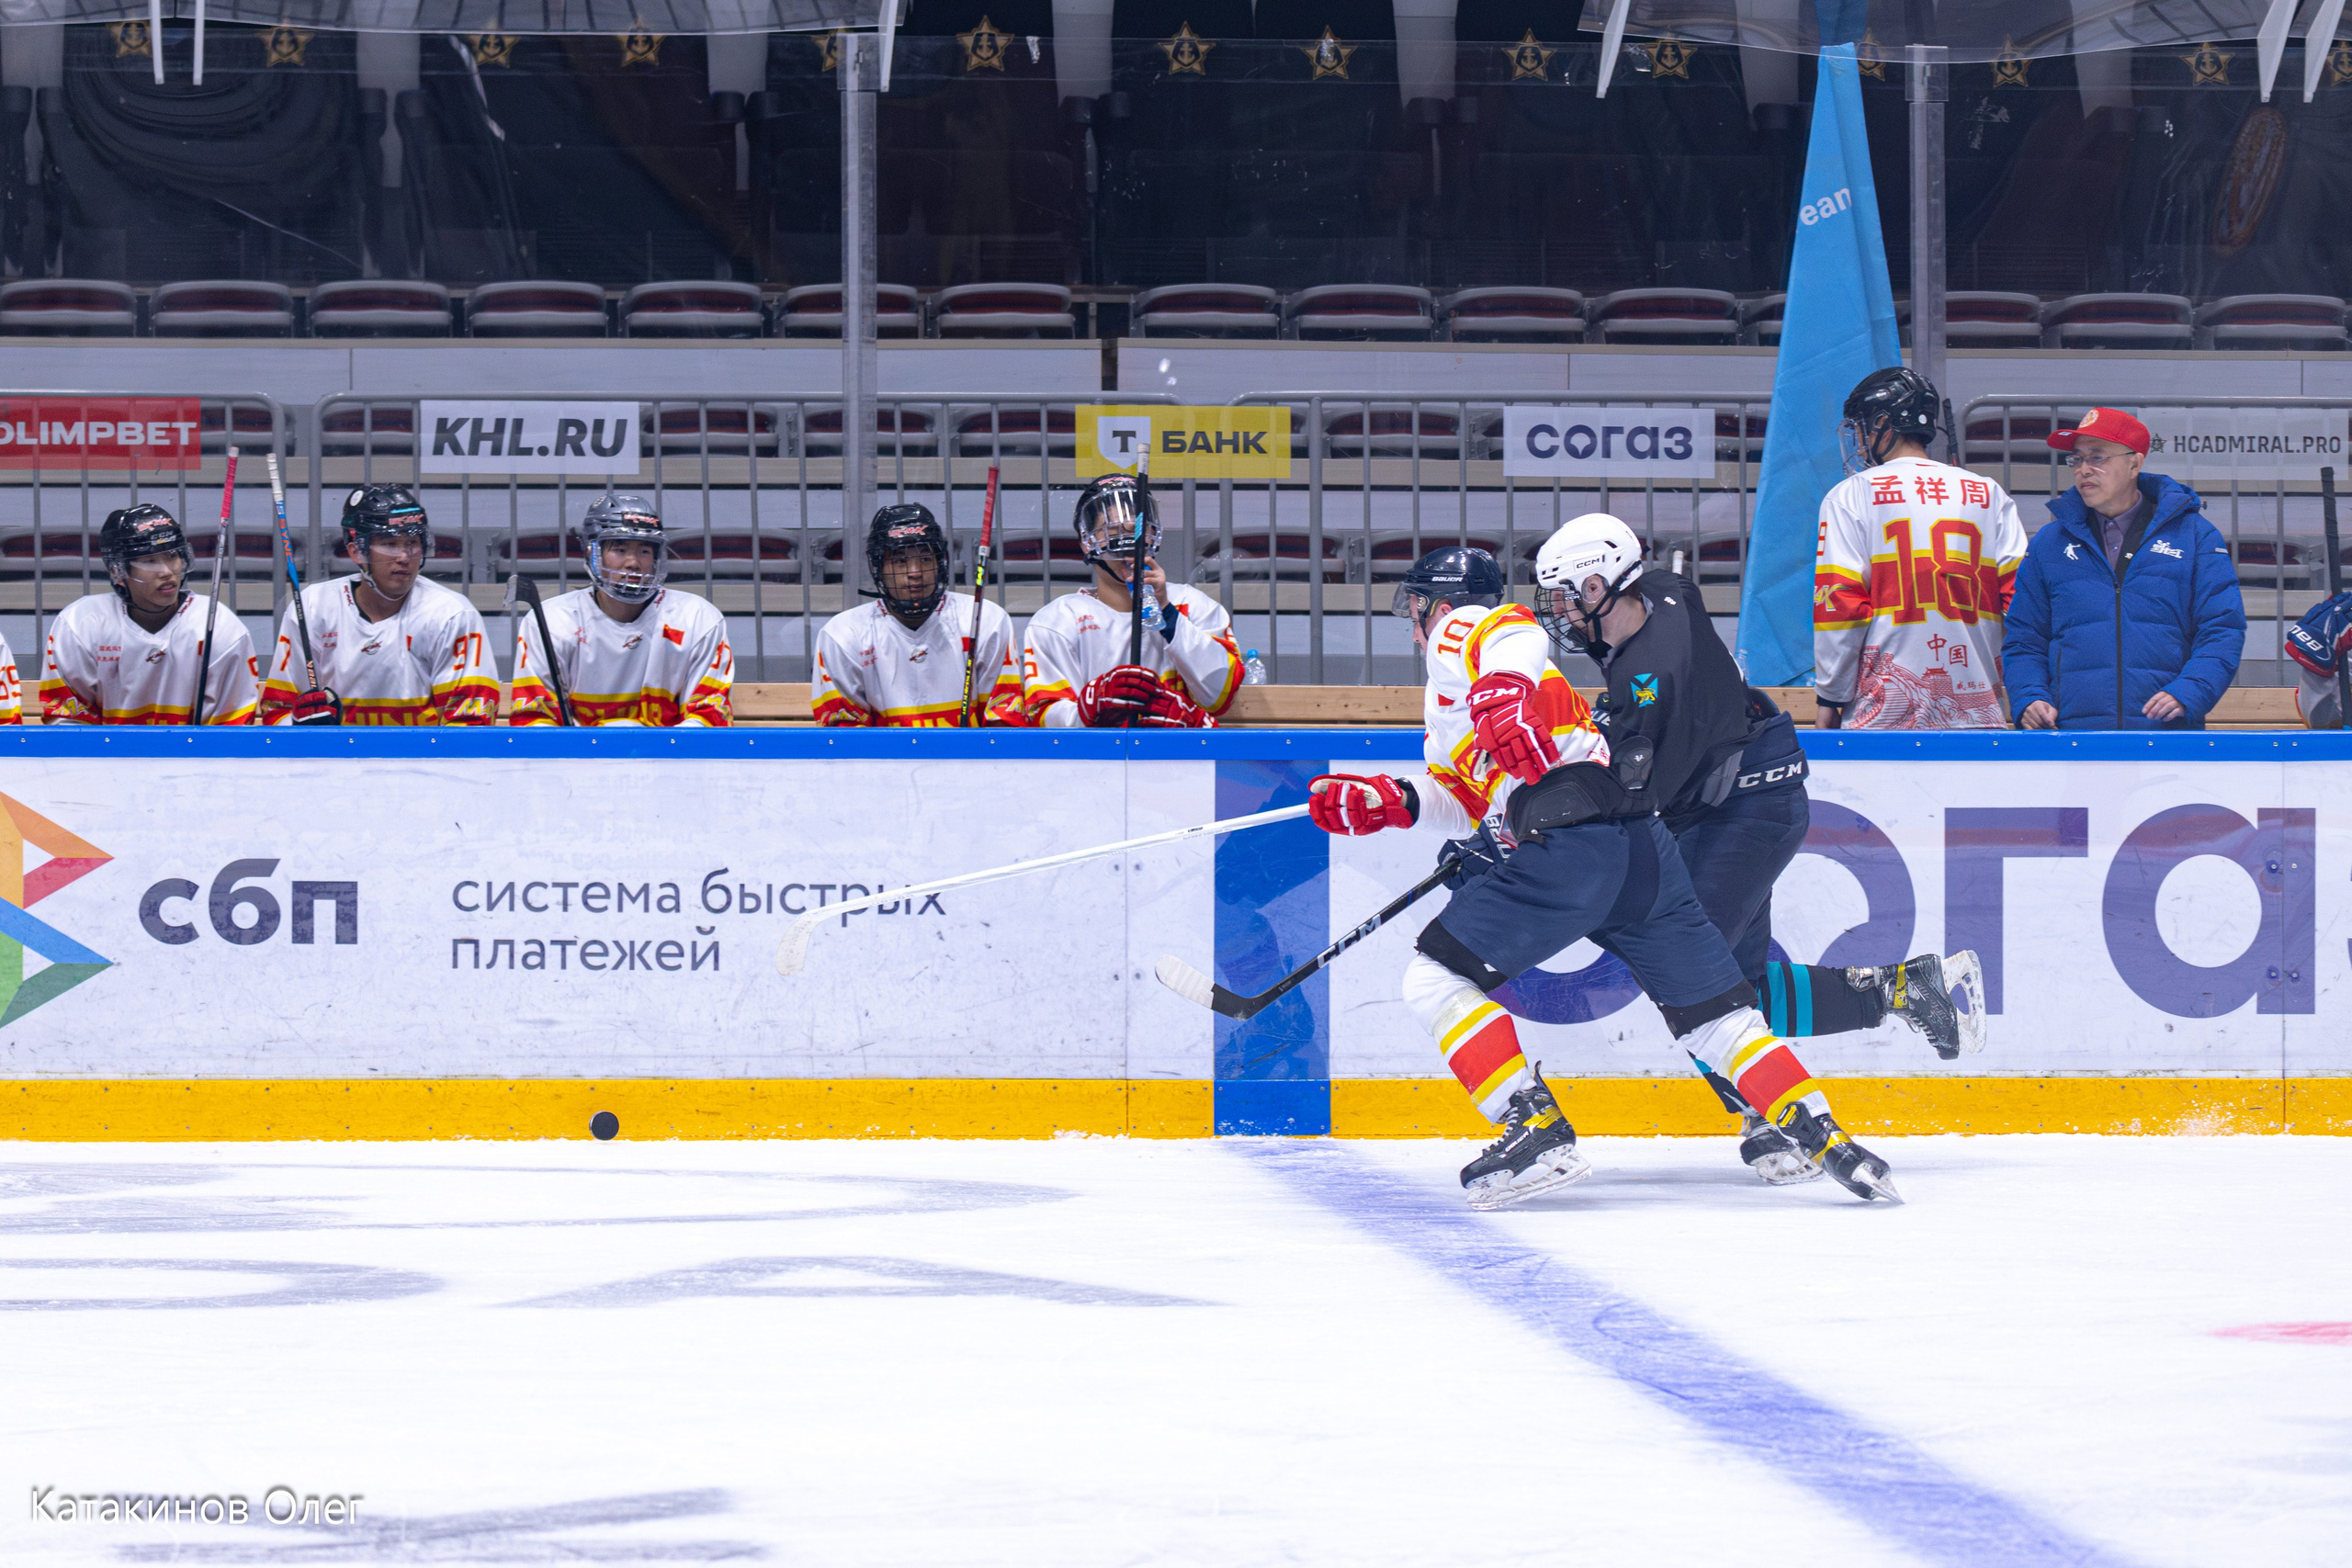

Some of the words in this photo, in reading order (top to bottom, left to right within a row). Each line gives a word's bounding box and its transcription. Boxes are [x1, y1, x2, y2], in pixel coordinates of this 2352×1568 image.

[433, 417, 628, 457] KHL.RU
[1162, 431, 1268, 454] БАНК
[2174, 435, 2341, 454] HCADMIRAL.PRO
[1871, 475, 1990, 510] 孟祥周
[1576, 558, 1600, 569] CCM
[1883, 517, 1983, 626] 18
[1437, 619, 1476, 658] 10
[1927, 633, 1968, 668] 中国
[1468, 687, 1520, 705] CM
[1738, 761, 1803, 788] CCM
[452, 880, 680, 913] система
[452, 925, 718, 971] платежей
[1317, 914, 1382, 968] CCM
